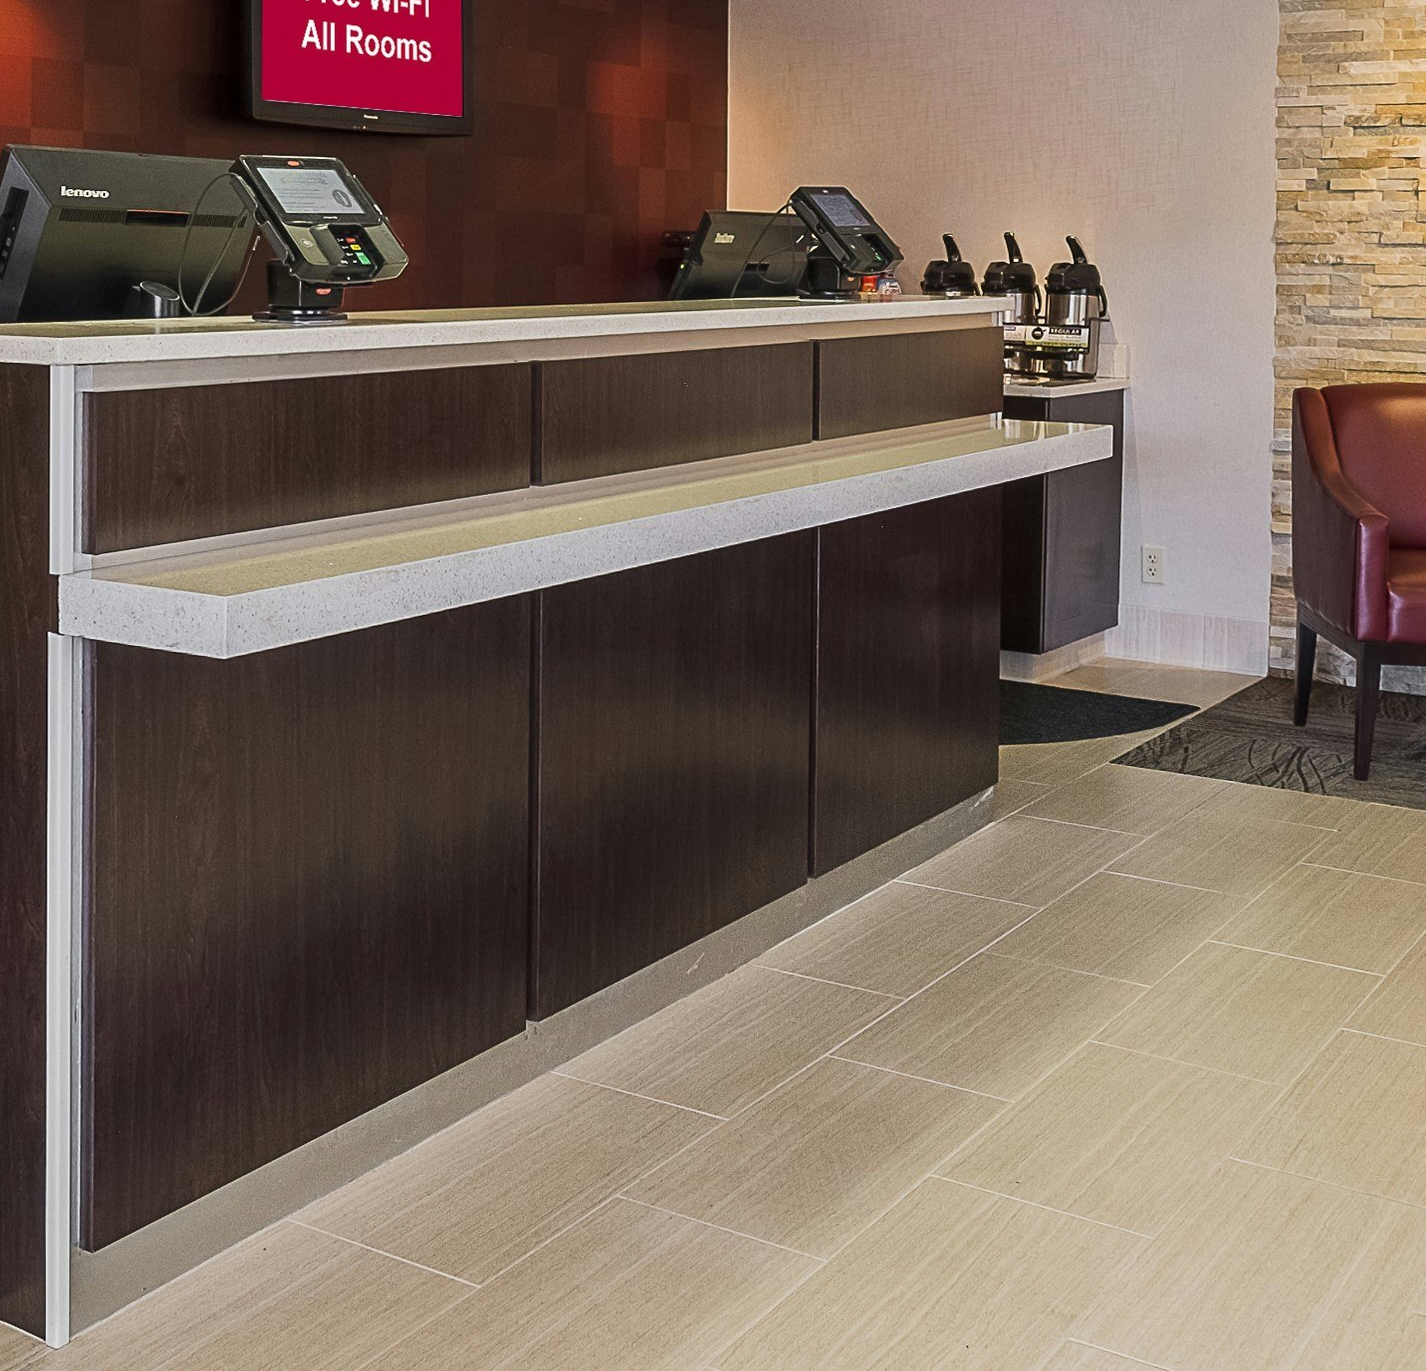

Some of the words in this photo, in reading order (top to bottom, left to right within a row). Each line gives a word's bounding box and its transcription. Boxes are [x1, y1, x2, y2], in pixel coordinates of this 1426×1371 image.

[301, 19, 336, 52] All
[345, 24, 432, 63] Rooms
[60, 185, 110, 199] lenovo
